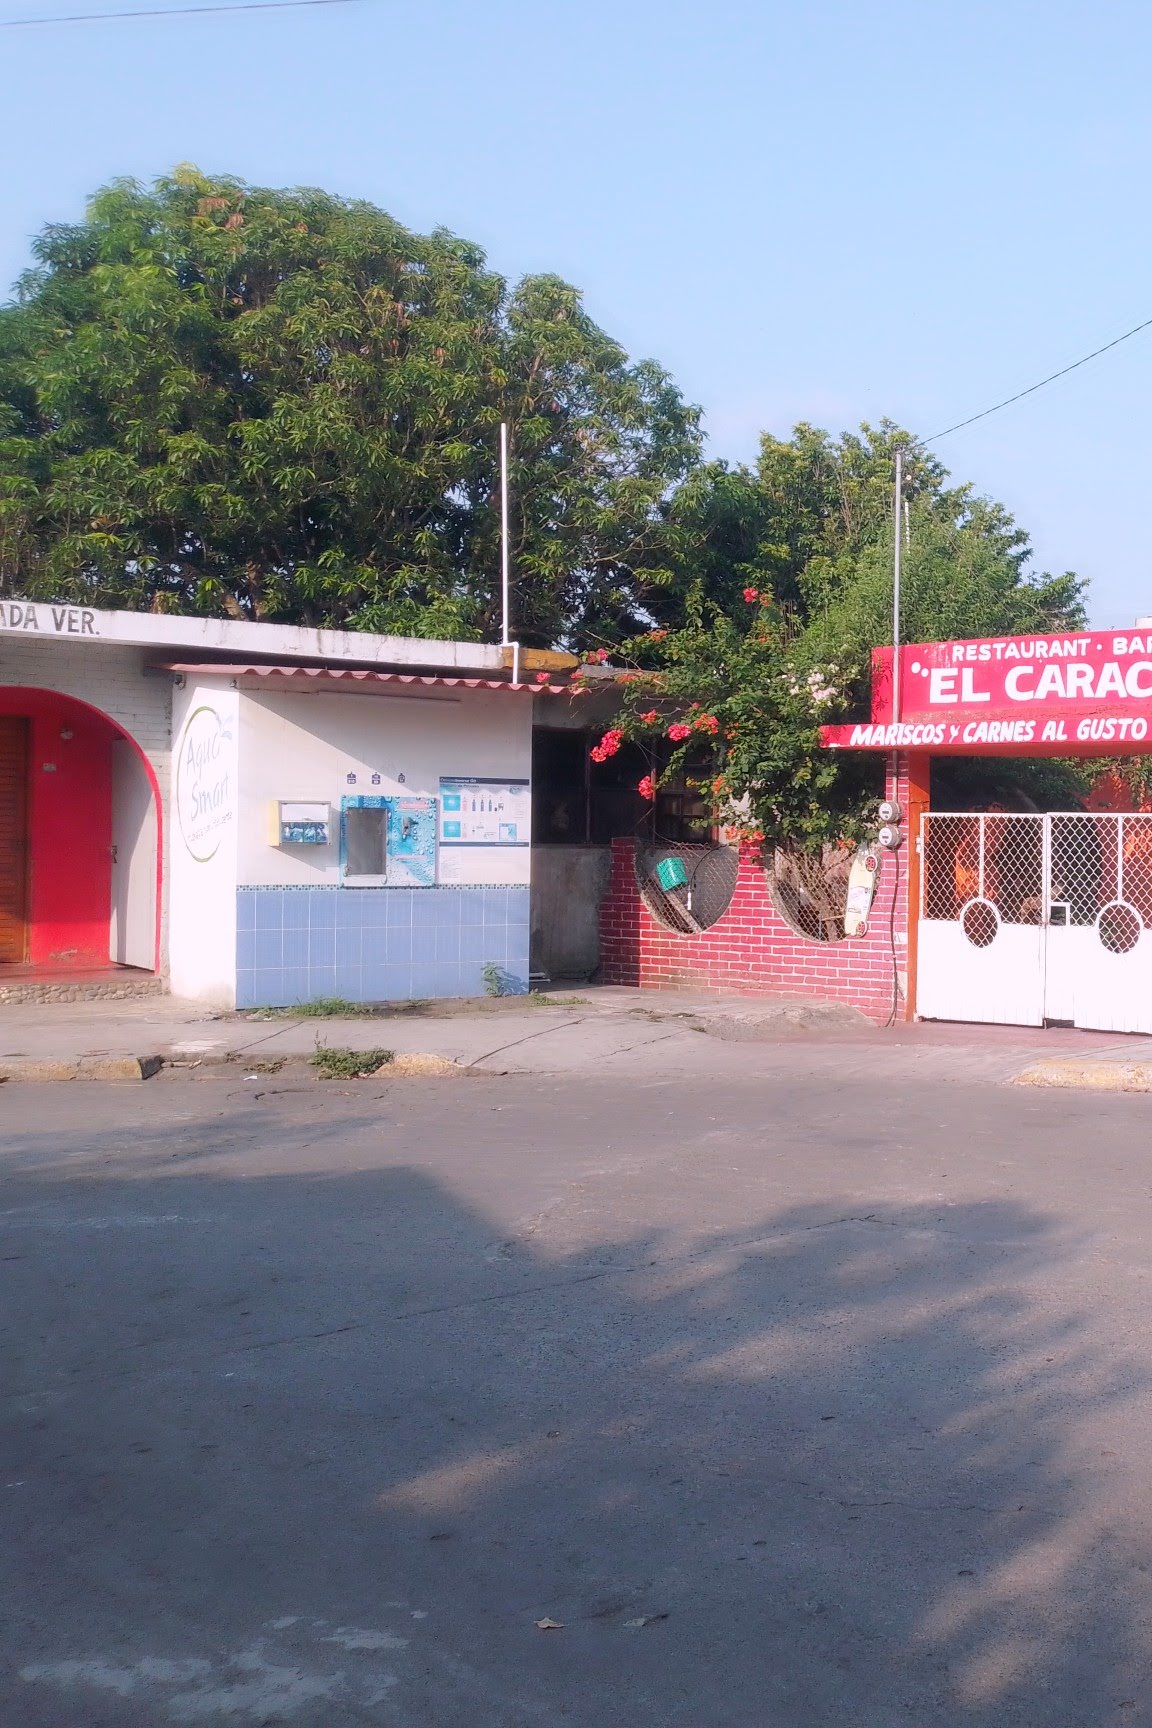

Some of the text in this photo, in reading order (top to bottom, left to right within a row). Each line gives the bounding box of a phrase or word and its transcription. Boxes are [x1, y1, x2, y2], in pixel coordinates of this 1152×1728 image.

[51, 607, 100, 635] VER.
[952, 638, 1091, 662] RESTAURANT
[929, 667, 991, 704] EL
[850, 723, 946, 746] MARISCOS
[962, 720, 1036, 743] CARNES
[1041, 720, 1068, 741] AL
[1076, 717, 1148, 741] GUSTO
